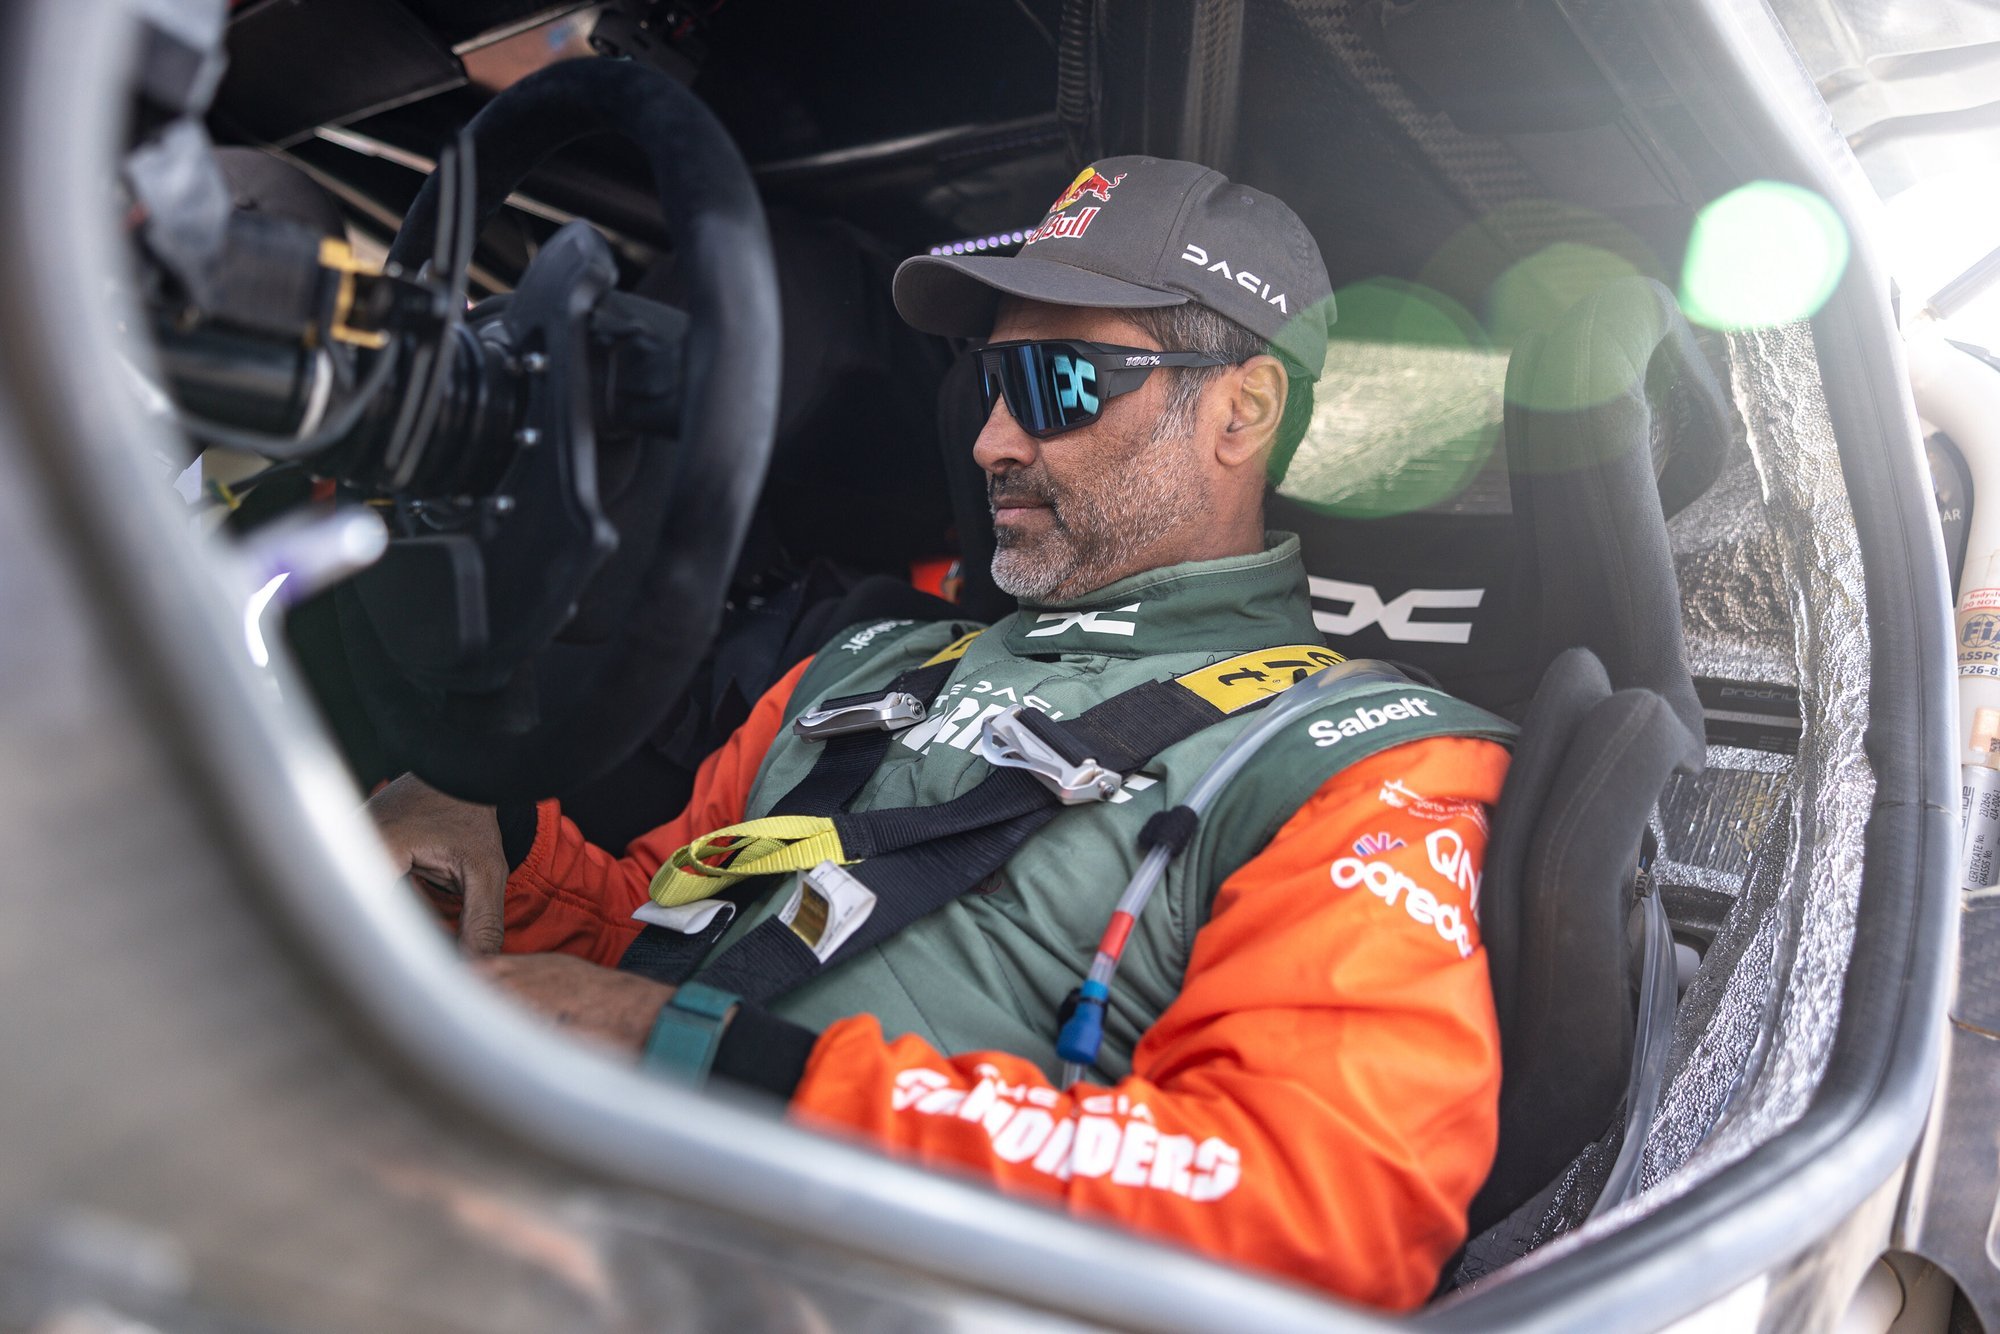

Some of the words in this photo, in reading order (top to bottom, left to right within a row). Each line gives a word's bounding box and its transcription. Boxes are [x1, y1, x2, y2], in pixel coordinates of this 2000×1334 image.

[1038, 207, 1102, 241] Bull
[1181, 243, 1288, 314] DACIA
[1124, 355, 1161, 367] 100%
[1957, 651, 2000, 662] ASSP
[1958, 665, 2000, 676] T-26-8
[971, 680, 1064, 721] DACI
[1720, 687, 1799, 703] prodriv
[1307, 696, 1438, 747] Sabelt
[1425, 828, 1482, 924] QN
[1967, 845, 1984, 883] CERTIFICATE
[1330, 857, 1474, 959] oored
